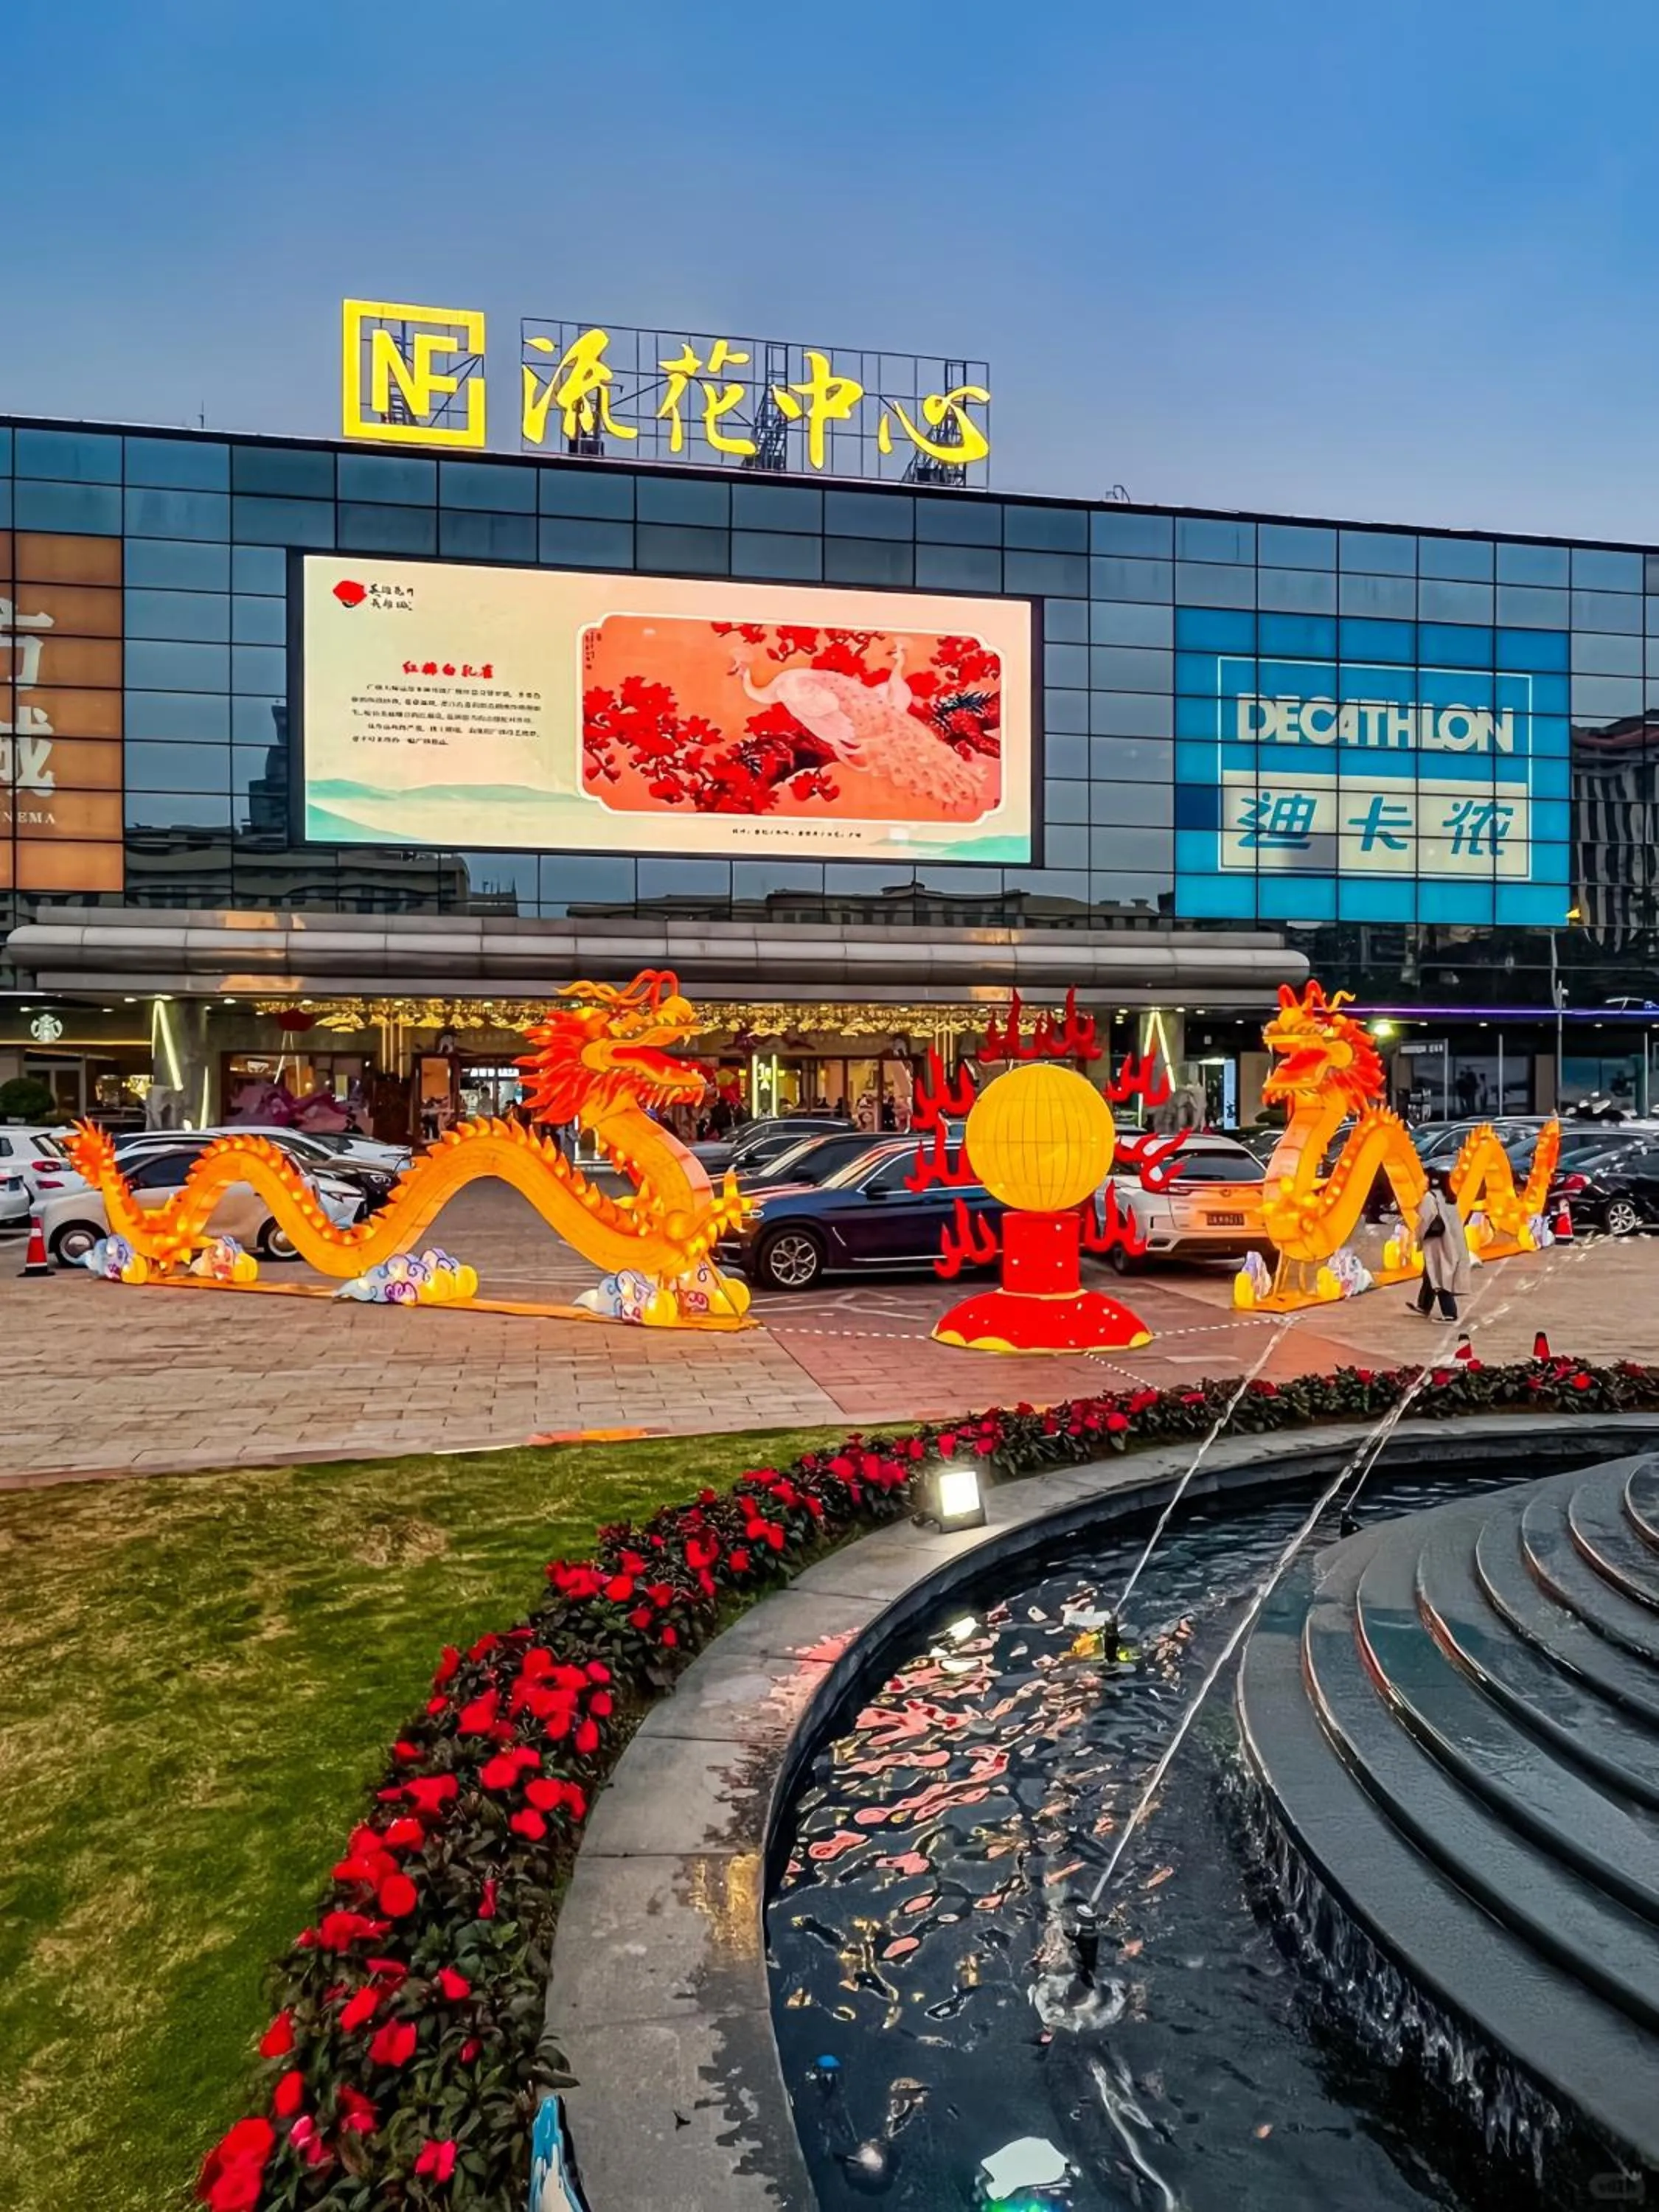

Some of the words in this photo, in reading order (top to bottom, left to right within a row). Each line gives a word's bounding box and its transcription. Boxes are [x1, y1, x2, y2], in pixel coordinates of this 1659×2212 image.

[522, 329, 990, 470] 流花中心
[1237, 692, 1514, 753] DECATHLON
[1237, 791, 1514, 856] 迪卡侬
